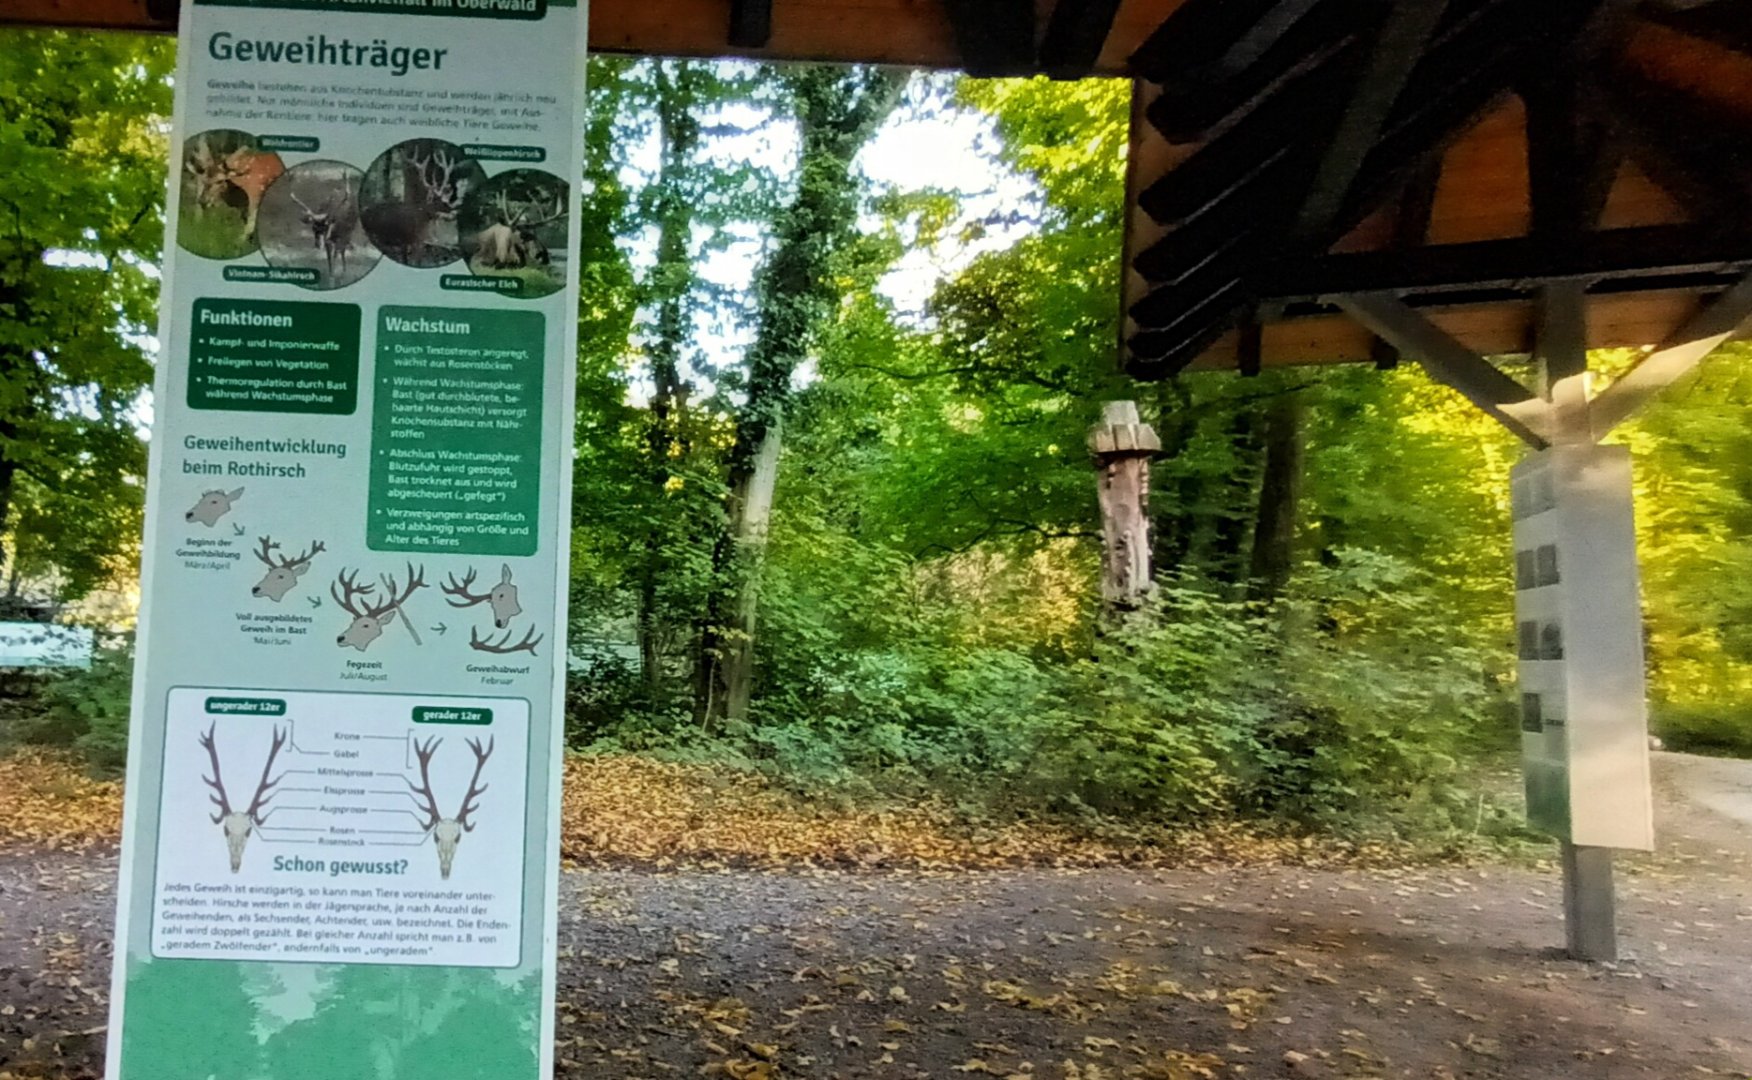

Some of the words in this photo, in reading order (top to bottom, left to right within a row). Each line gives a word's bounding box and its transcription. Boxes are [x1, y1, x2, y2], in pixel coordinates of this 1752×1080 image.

[208, 31, 448, 76] Geweihträger
[207, 79, 255, 90] Geweihe
[427, 89, 448, 99] und
[451, 91, 491, 101] werden
[536, 96, 556, 104] neu
[257, 95, 276, 104] Nur
[245, 109, 263, 119] der
[318, 113, 338, 122] hier
[342, 114, 377, 125] tragen
[380, 116, 406, 125] auch
[409, 116, 459, 128] weibliche
[463, 118, 489, 129] Tiere
[445, 277, 497, 288] Eurasischer
[499, 279, 519, 289] Elch
[200, 309, 293, 327] Funktionen
[385, 316, 470, 334] Wachstum
[209, 337, 244, 348] Kampf-
[247, 338, 267, 348] und
[269, 339, 340, 350] Imponierwaffe
[394, 344, 423, 354] Durch
[427, 345, 481, 356] Testosteron
[483, 348, 529, 360] angeregt,
[208, 356, 252, 368] Freilegen
[255, 359, 273, 368] von
[275, 359, 329, 371] Vegetation
[394, 357, 427, 367] wächst
[429, 359, 447, 368] aus
[207, 376, 294, 389] Thermoregulation
[296, 379, 324, 389] durch
[327, 381, 348, 390] Bast
[393, 376, 437, 387] Während
[439, 378, 524, 391] Wachstumsphase:
[205, 389, 249, 399] während
[251, 390, 333, 403] Wachstumsphase
[392, 390, 413, 399] Bast
[415, 390, 435, 401] (gut
[437, 391, 501, 403] durchblutete,
[504, 393, 520, 403] be-
[391, 402, 423, 412] haarte
[425, 404, 486, 417] Hautschicht)
[488, 407, 527, 418] versorgt
[391, 416, 474, 428] Knochensubstanz
[477, 419, 494, 428] mit
[496, 419, 523, 429] Nähr-
[390, 429, 425, 439] stoffen
[184, 434, 347, 459] Geweihentwicklung
[389, 448, 435, 459] Abschluss
[437, 450, 522, 463] Wachstumsphase:
[182, 459, 222, 476] beim
[228, 460, 306, 478] Rothirsch
[388, 461, 440, 472] Blutzufuhr
[443, 464, 465, 473] wird
[467, 466, 513, 476] gestoppt,
[388, 474, 409, 484] Bast
[411, 475, 452, 485] trocknet
[454, 478, 471, 486] aus
[473, 478, 492, 487] und
[495, 479, 517, 488] wird
[387, 488, 452, 500] abgescheuert
[386, 507, 463, 520] Verzweigungen
[465, 510, 525, 522] artspezifisch
[386, 522, 406, 531] und
[407, 522, 454, 534] abhängig
[456, 525, 474, 533] von
[476, 524, 507, 535] Größe
[509, 526, 529, 535] und
[186, 538, 216, 548] Beginn
[217, 538, 232, 547] der
[385, 534, 409, 544] Alter
[412, 535, 429, 545] des
[431, 535, 460, 545] Tieres
[176, 549, 241, 560] Geweihbildung
[236, 612, 252, 621] Voll
[254, 613, 313, 624] ausgebildetes
[240, 624, 273, 633] Geweih
[275, 625, 286, 634] im
[288, 626, 307, 634] Bast
[346, 660, 382, 670] Fegezeit
[466, 663, 530, 674] Geweihabwurf
[340, 672, 388, 682] Juli/August
[481, 676, 514, 685] Februar
[210, 700, 258, 712] ungerader
[260, 701, 281, 712] 12er
[423, 710, 459, 721] gerader
[461, 710, 482, 721] 12er
[334, 732, 361, 741] Krone
[333, 750, 359, 758] Gabel
[317, 767, 374, 778] Mittelsprosse
[319, 804, 368, 815] Augsprosse
[329, 826, 355, 834] Rosen
[318, 837, 365, 847] Rosenstock
[273, 855, 325, 873] Schon
[330, 858, 409, 877] gewusst?
[164, 883, 191, 893] Jedes
[194, 883, 232, 894] Geweih
[234, 884, 246, 893] ist
[249, 885, 305, 897] einzigartig,
[308, 888, 319, 896] so
[322, 887, 347, 896] kann
[351, 889, 372, 898] man
[375, 888, 399, 898] Tiere
[402, 890, 463, 900] voreinander
[465, 892, 496, 901] unter-
[163, 897, 207, 906] scheiden.
[212, 898, 249, 908] Hirsche
[252, 899, 290, 909] werden
[293, 900, 303, 909] in
[304, 900, 321, 910] der
[325, 900, 392, 914] Jägersprache,
[395, 904, 404, 915] je
[407, 904, 431, 913] nach
[433, 904, 469, 914] Anzahl
[471, 905, 487, 915] der
[162, 910, 234, 923] Geweihenden,
[238, 913, 250, 923] als
[254, 913, 311, 925] Sechsender,
[315, 915, 368, 927] Achtender,
[372, 917, 392, 927] usw.
[396, 918, 453, 928] bezeichnet.
[457, 918, 474, 928] Die
[476, 919, 512, 930] Enden-
[161, 925, 182, 935] zahl
[185, 926, 208, 936] wird
[210, 926, 250, 937] doppelt
[253, 927, 293, 939] gezählt.
[296, 929, 312, 938] Bei
[315, 929, 354, 941] gleicher
[357, 931, 393, 940] Anzahl
[395, 932, 429, 943] spricht
[431, 934, 453, 942] man
[478, 935, 496, 943] von
[161, 939, 211, 951] „geradem
[284, 942, 340, 953] andernfalls
[343, 945, 361, 954] von
